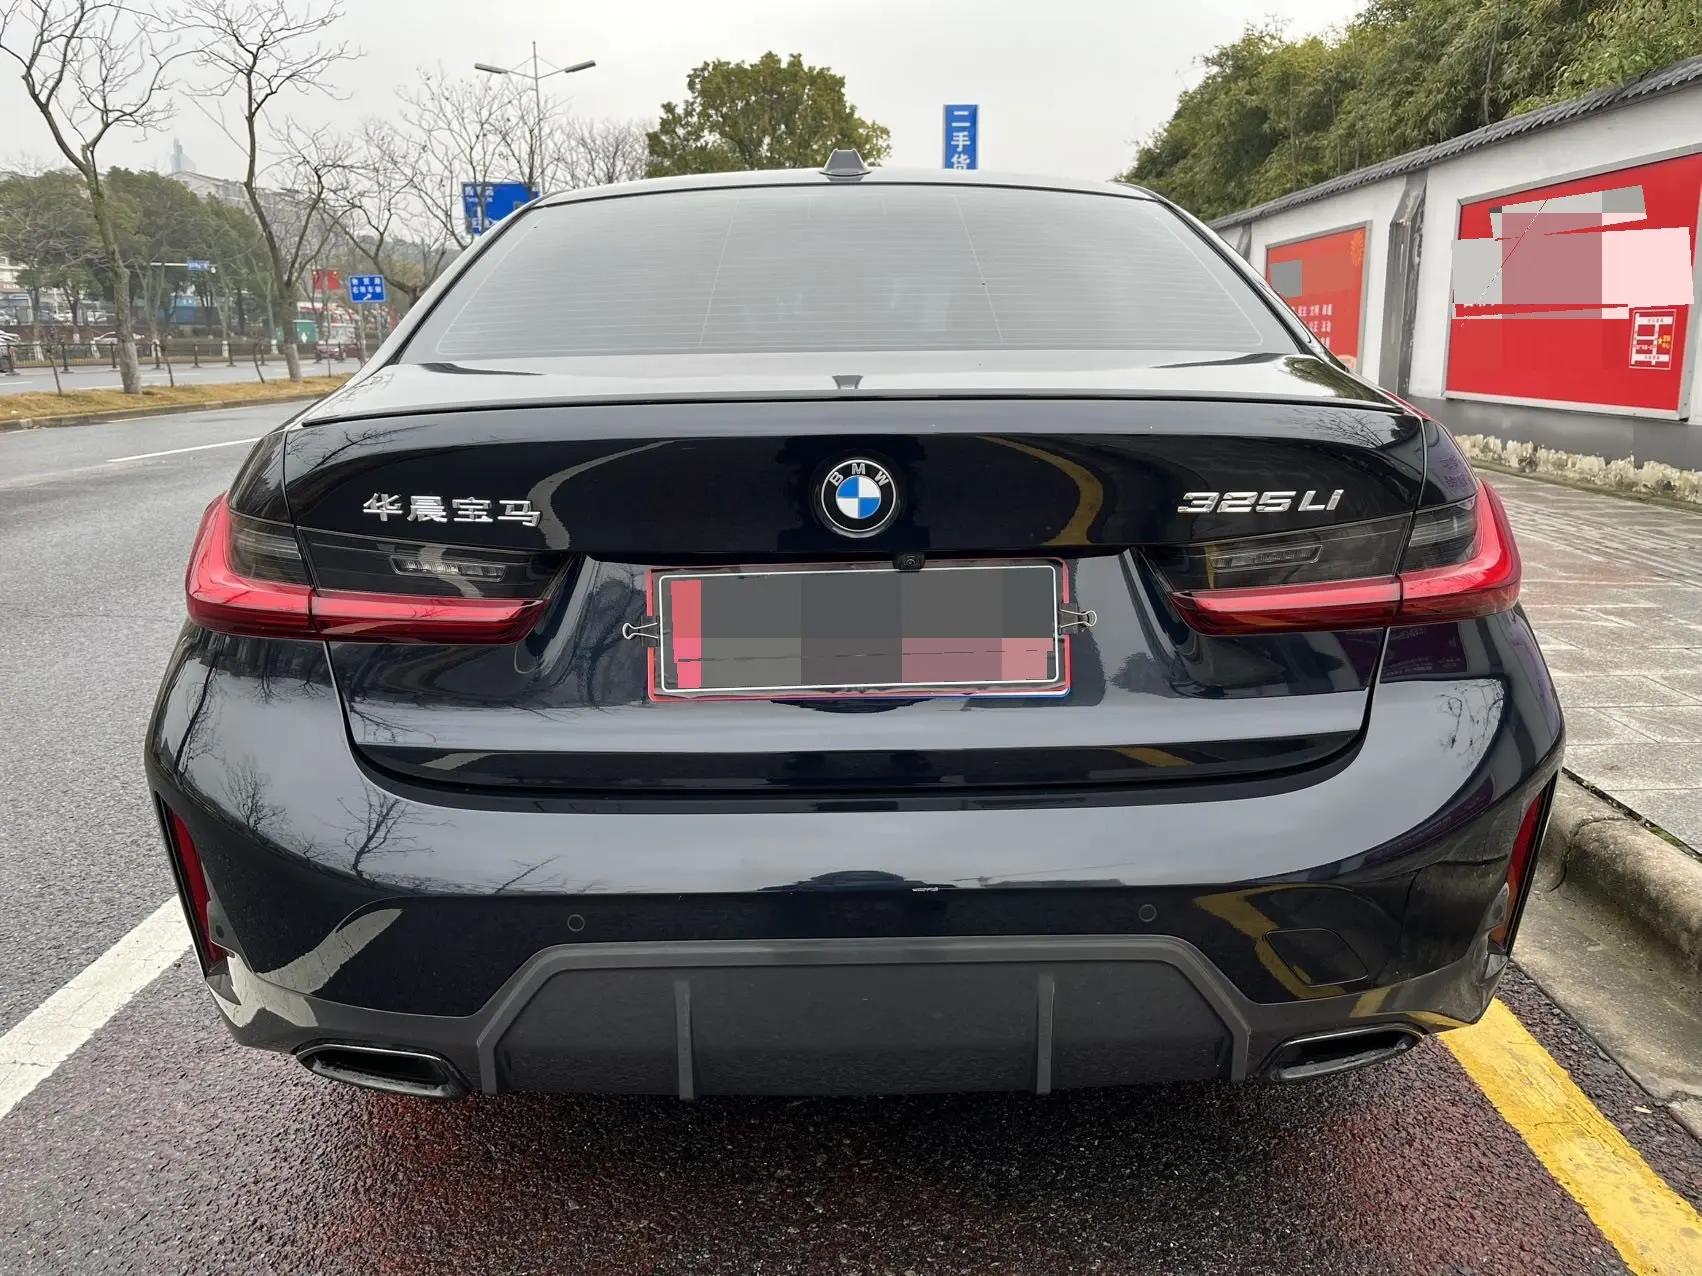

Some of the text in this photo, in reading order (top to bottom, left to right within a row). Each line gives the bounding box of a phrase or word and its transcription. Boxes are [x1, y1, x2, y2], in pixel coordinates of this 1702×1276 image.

[829, 463, 890, 487] BMW
[363, 493, 541, 527] 华晨宝马
